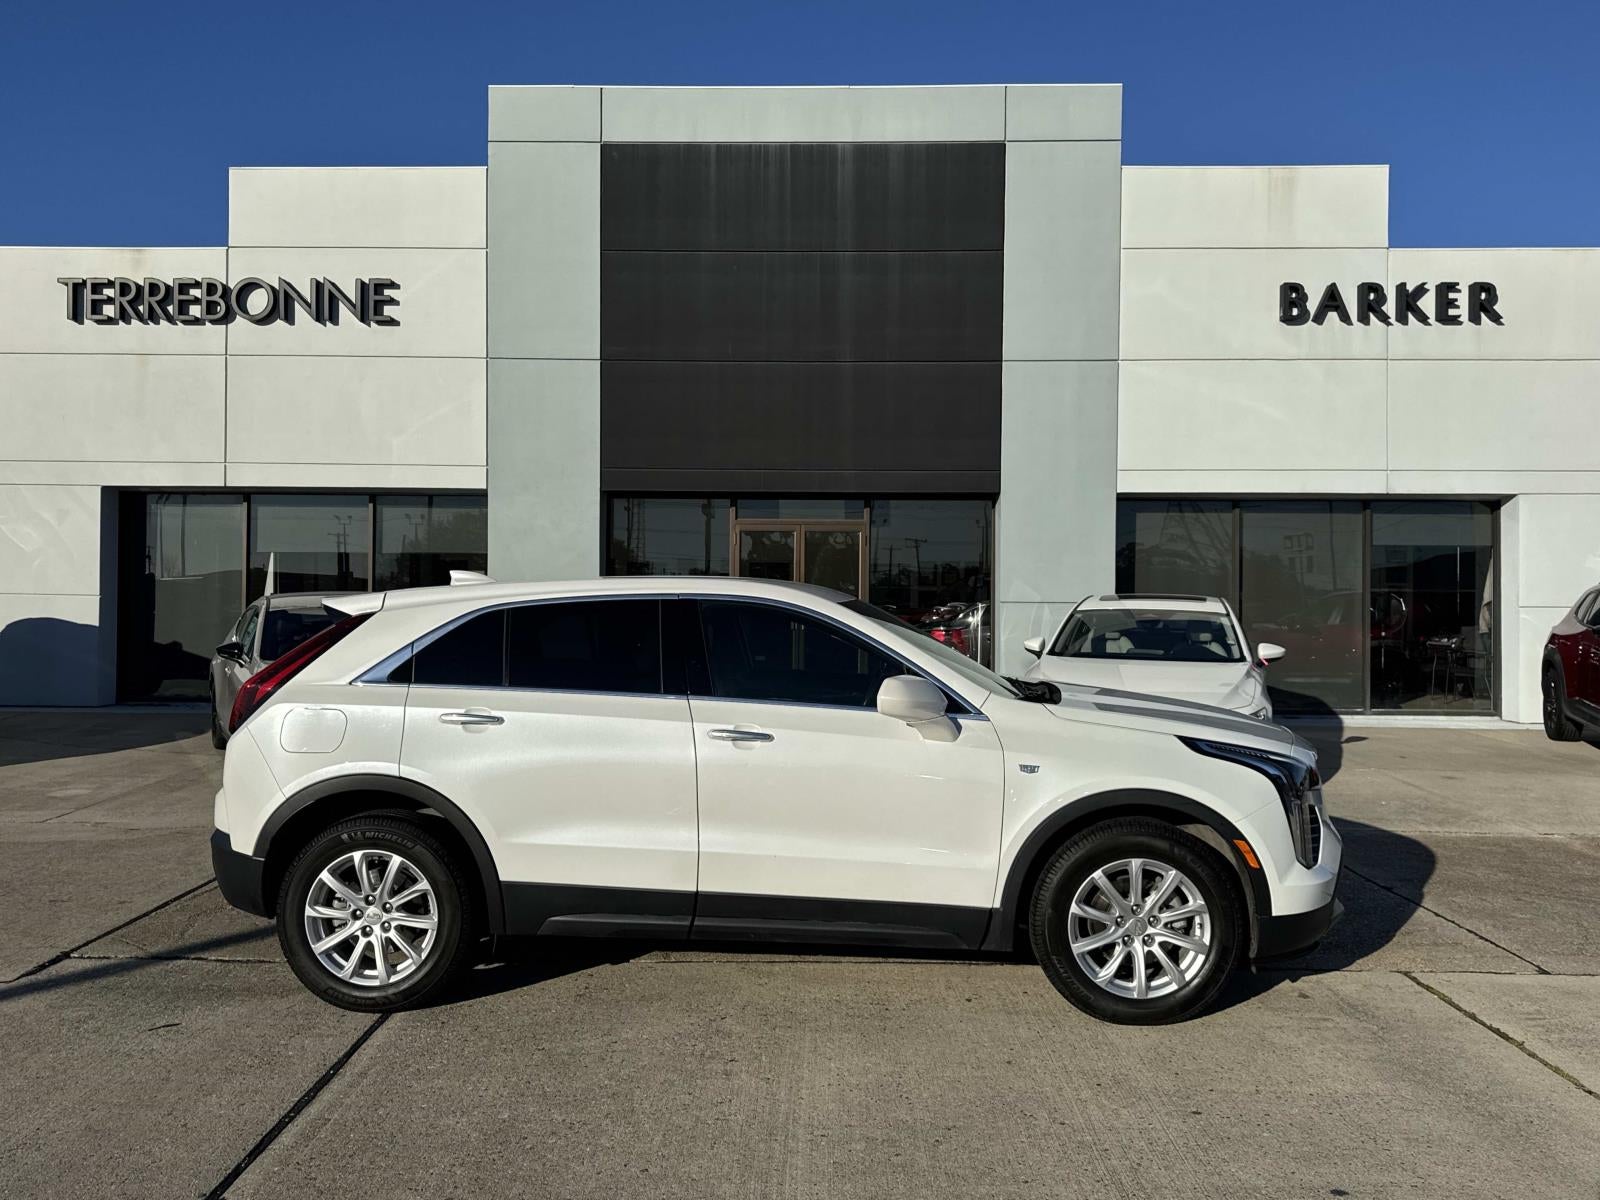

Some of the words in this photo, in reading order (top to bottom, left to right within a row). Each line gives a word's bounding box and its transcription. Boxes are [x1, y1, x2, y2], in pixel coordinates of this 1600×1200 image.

[57, 276, 400, 327] TERREBONNE
[1279, 281, 1505, 326] BARKER
[365, 831, 415, 848] MICHELIN
